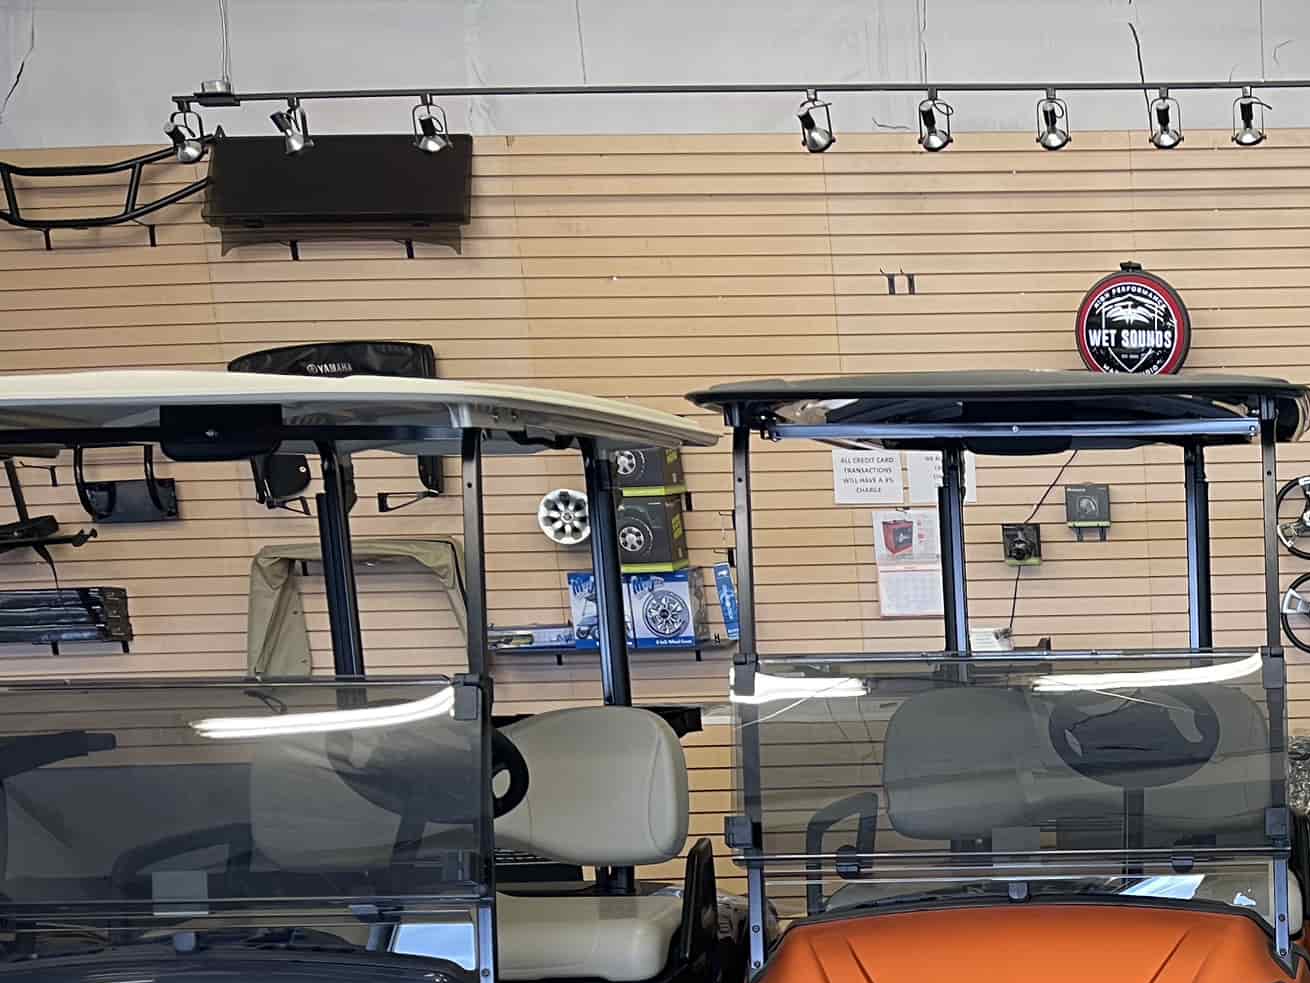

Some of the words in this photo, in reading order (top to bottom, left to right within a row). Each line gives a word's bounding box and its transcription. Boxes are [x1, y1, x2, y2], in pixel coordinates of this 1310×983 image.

[1111, 286, 1167, 311] PERFORMANCE
[1089, 328, 1117, 347] WET
[1121, 329, 1172, 349] SOUNDS
[840, 456, 852, 464] ALL
[852, 456, 875, 464] CREDIT
[876, 455, 895, 464] CARD
[843, 466, 893, 474] TRANSACTIONS
[855, 486, 881, 494] CHARGE
